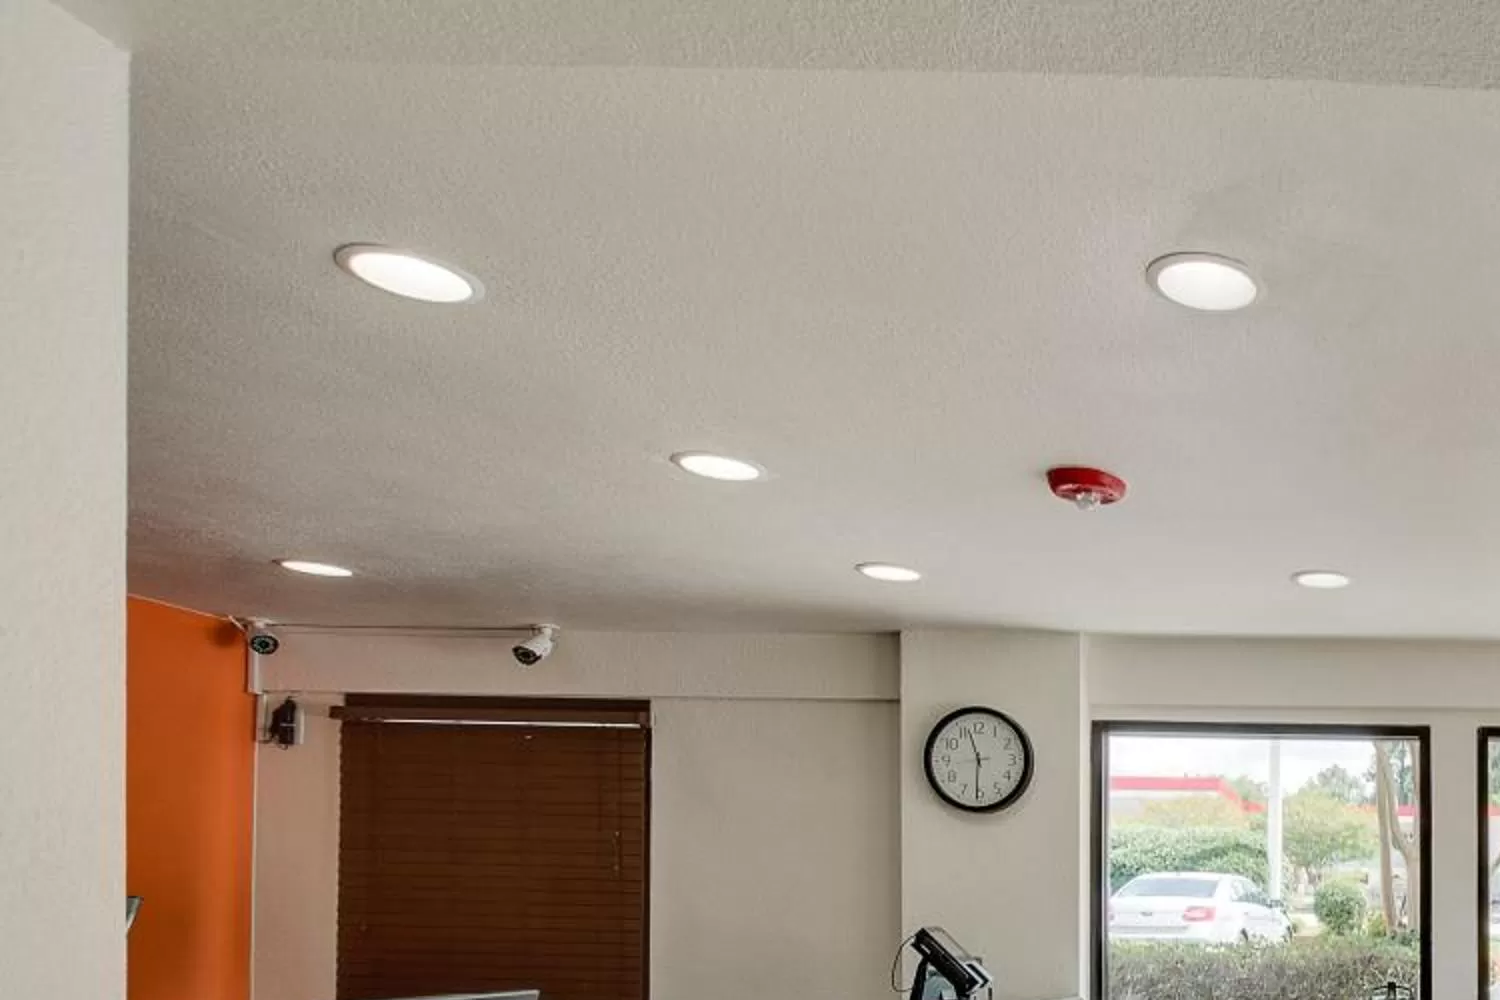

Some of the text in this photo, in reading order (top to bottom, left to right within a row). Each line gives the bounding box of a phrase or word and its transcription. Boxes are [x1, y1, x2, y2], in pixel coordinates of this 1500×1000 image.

[959, 726, 967, 739] 11
[973, 721, 985, 735] 12
[946, 738, 959, 751] 10
[1004, 738, 1014, 750] 2
[941, 755, 951, 768] 9
[1008, 753, 1017, 766] 3
[948, 770, 957, 782] 8
[1003, 770, 1011, 781] 4
[961, 784, 968, 796] 7
[994, 782, 1001, 795] 5
